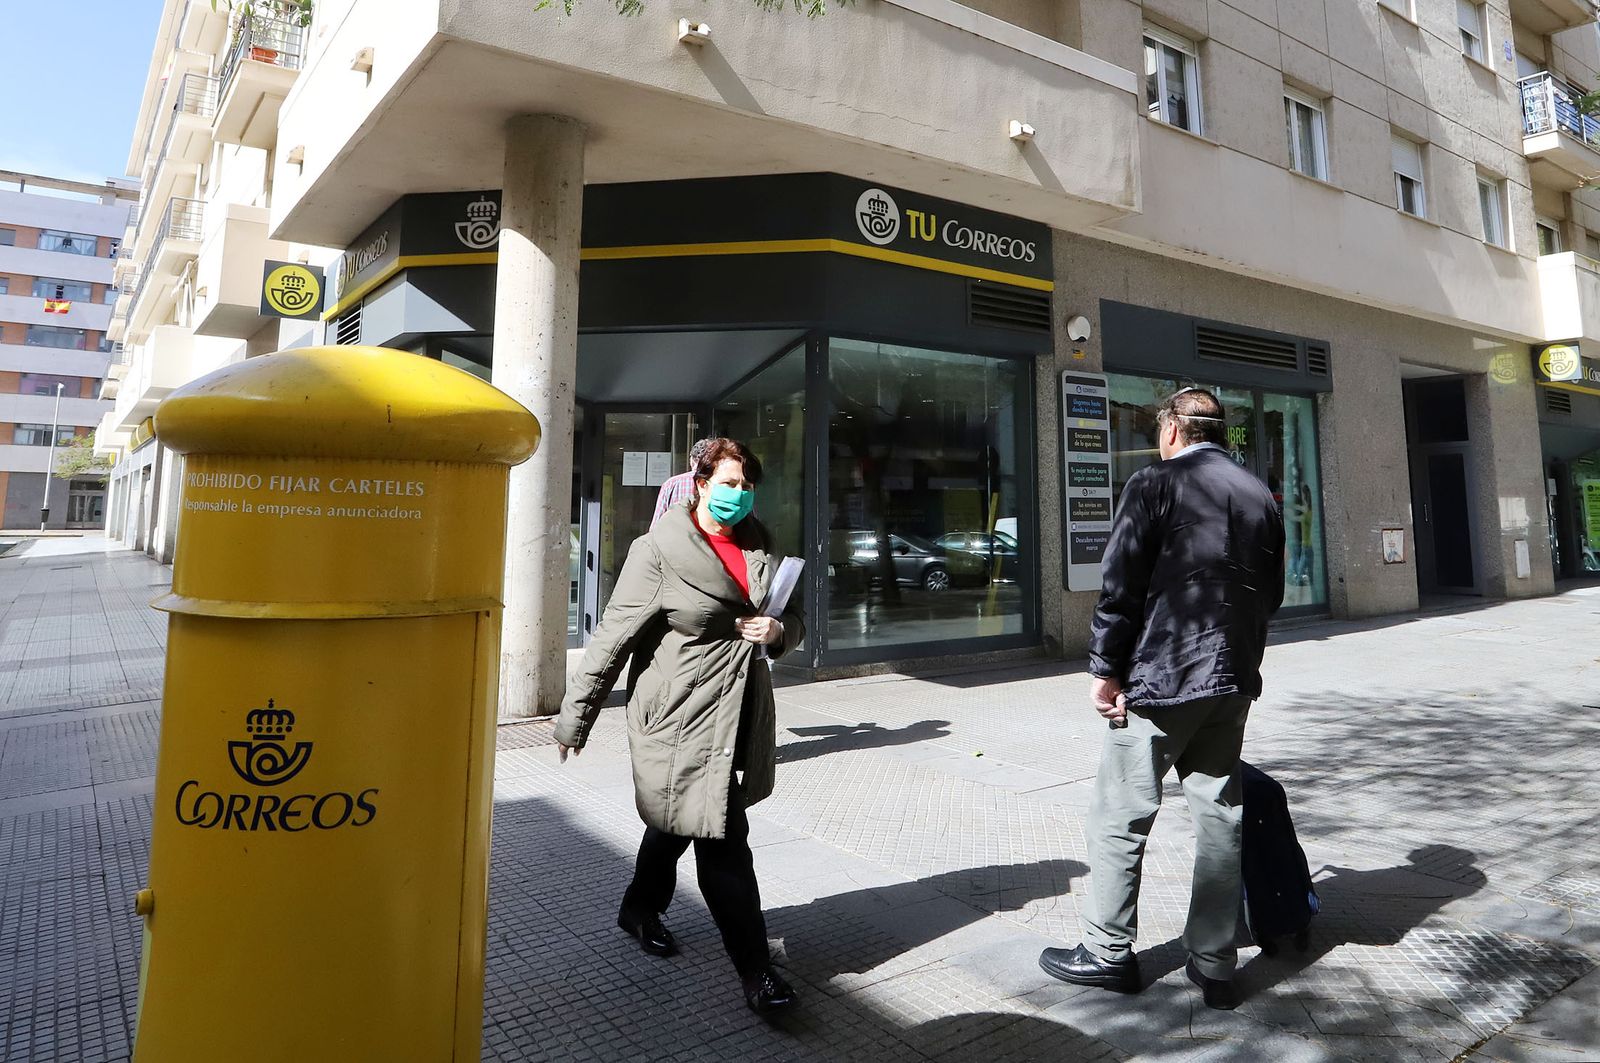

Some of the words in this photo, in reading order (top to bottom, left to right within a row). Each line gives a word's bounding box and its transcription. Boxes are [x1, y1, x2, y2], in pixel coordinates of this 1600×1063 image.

[906, 209, 936, 242] TU
[942, 219, 1036, 263] CORREOS
[186, 472, 262, 490] PROHIBIDO
[269, 475, 321, 494] FIJAR
[329, 478, 424, 497] CARTELES
[242, 499, 252, 513] la
[257, 502, 321, 518] empresa
[327, 505, 422, 520] anunciadora
[175, 780, 379, 832] CORREOS
